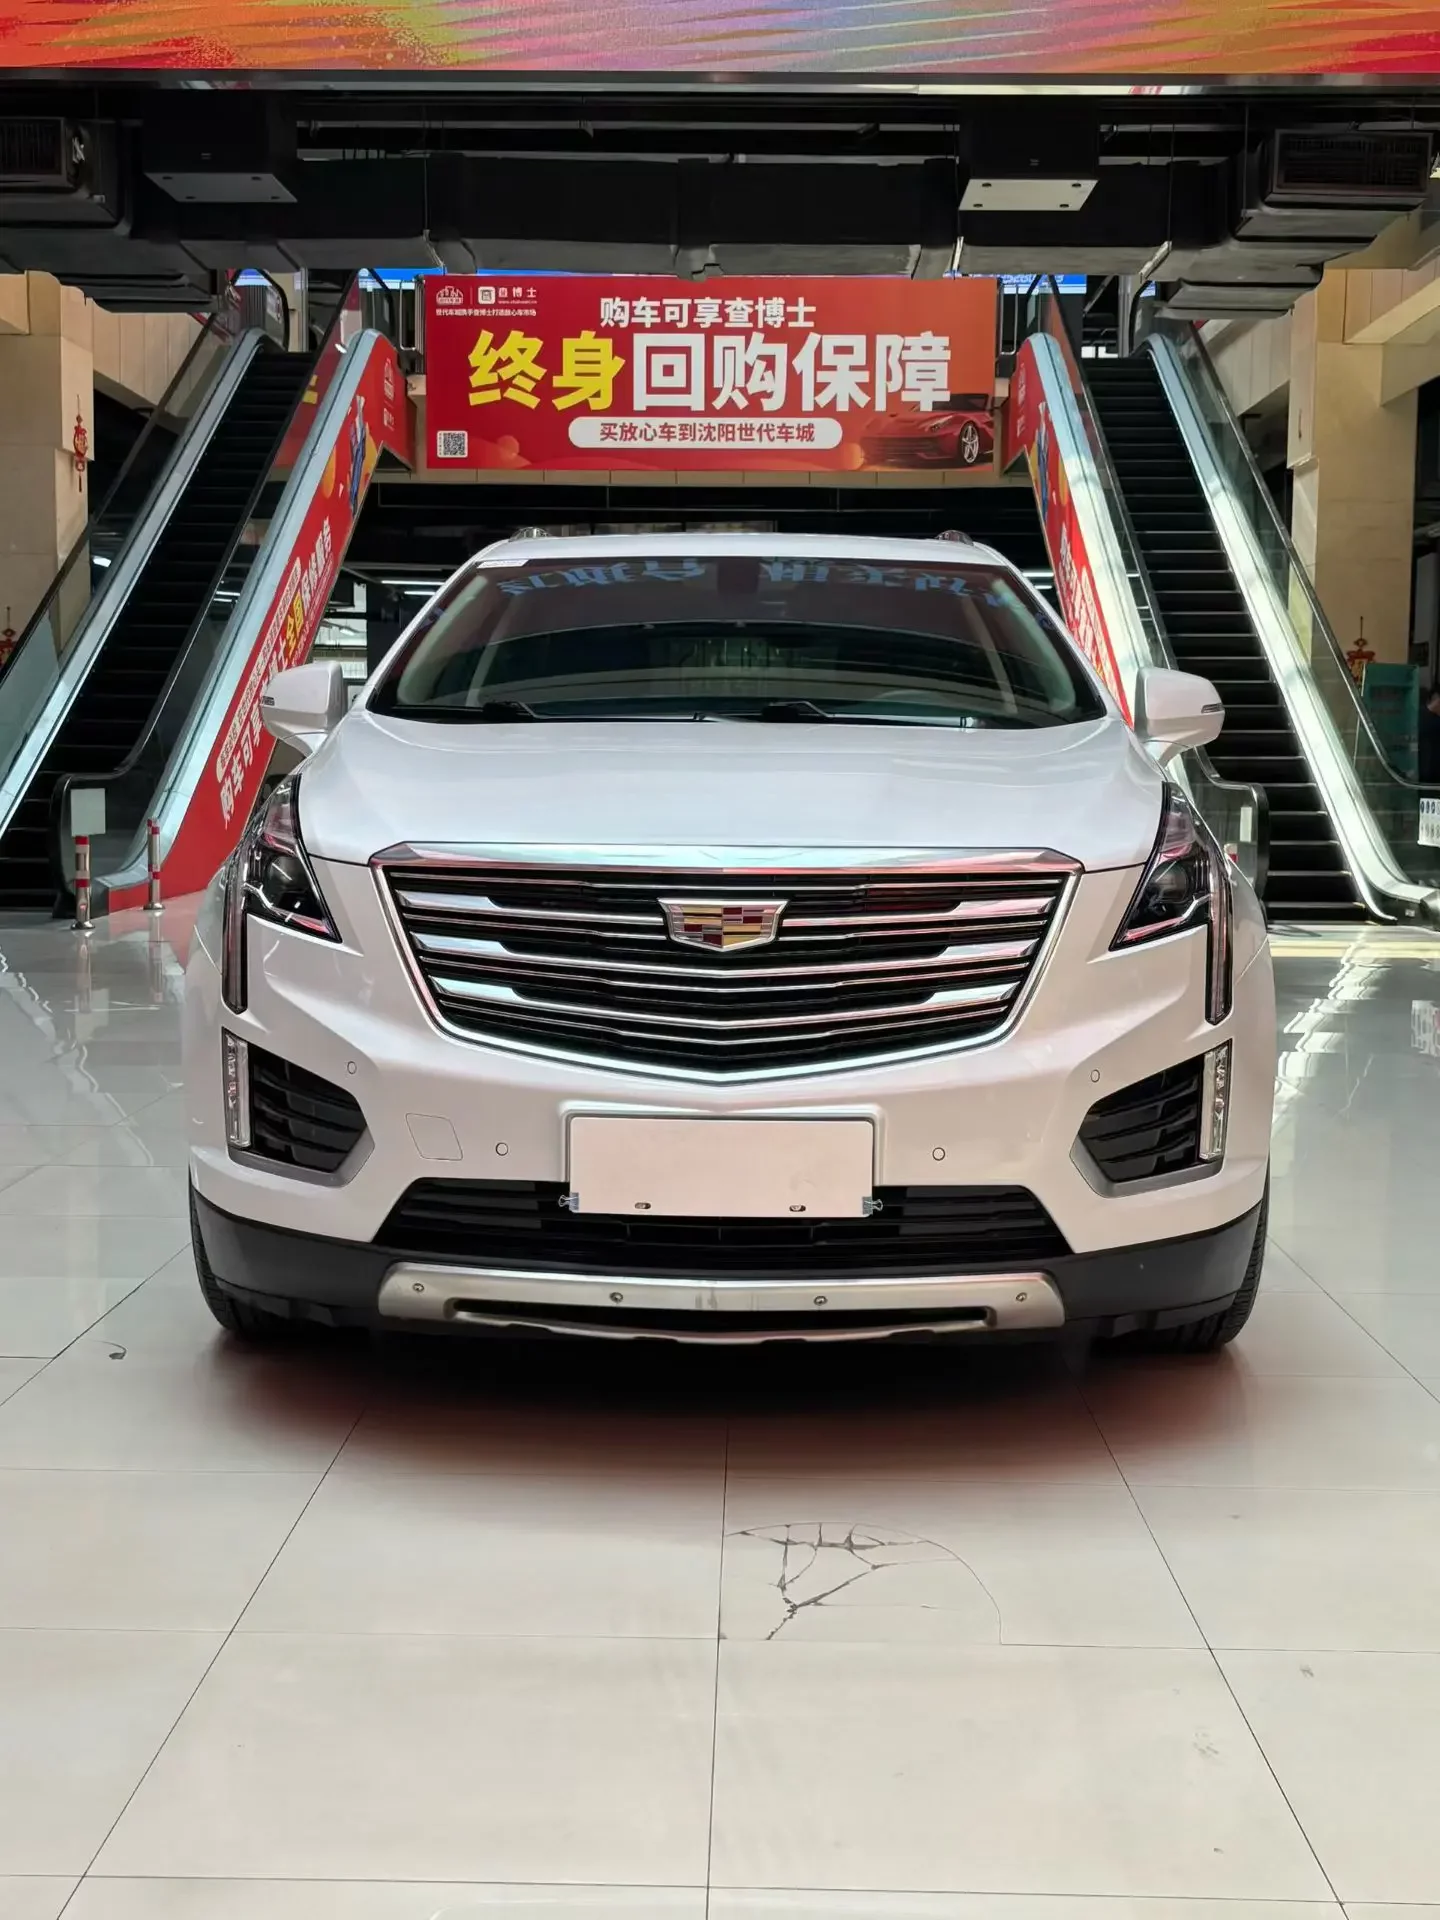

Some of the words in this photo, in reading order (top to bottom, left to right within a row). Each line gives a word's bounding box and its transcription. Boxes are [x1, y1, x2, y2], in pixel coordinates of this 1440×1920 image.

[600, 297, 816, 329] 购车可享查博士
[468, 331, 951, 412] 终身回购保障
[600, 422, 815, 443] 买放心车到沈阳世代车城
